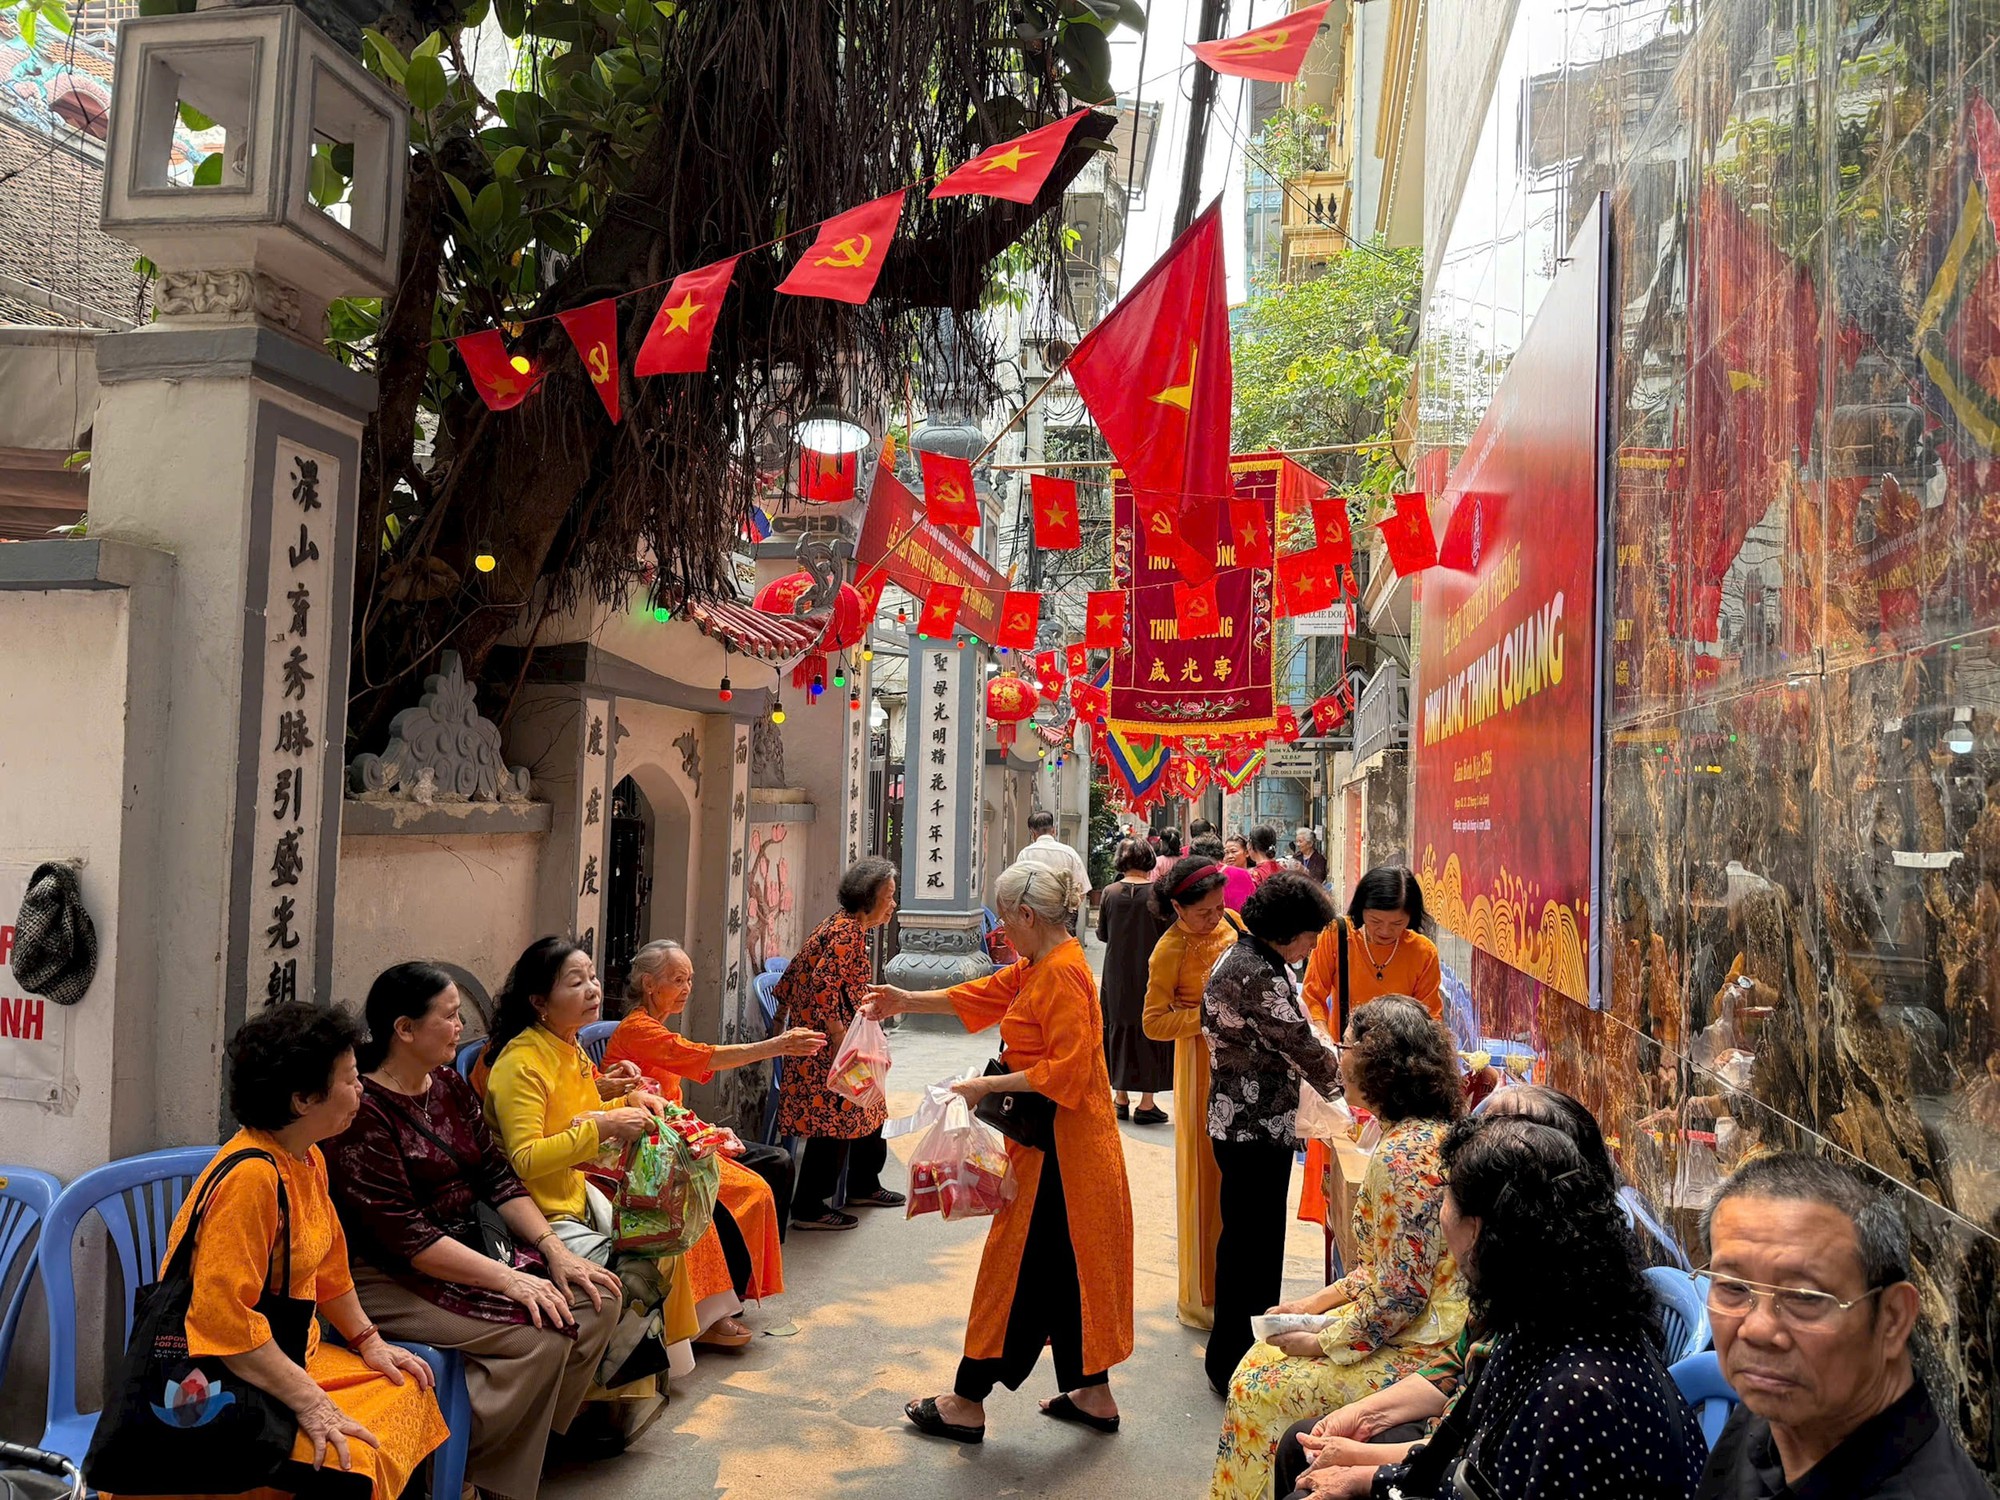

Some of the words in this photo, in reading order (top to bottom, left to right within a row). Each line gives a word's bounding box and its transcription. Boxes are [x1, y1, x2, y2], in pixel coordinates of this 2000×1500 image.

[1490, 538, 1521, 612] THỐNG
[1150, 618, 1180, 644] THỊN
[1328, 609, 1347, 619] DOL
[1441, 674, 1465, 740] LÀNG
[1467, 640, 1500, 731] THỊNH
[1501, 591, 1564, 712] QUANG
